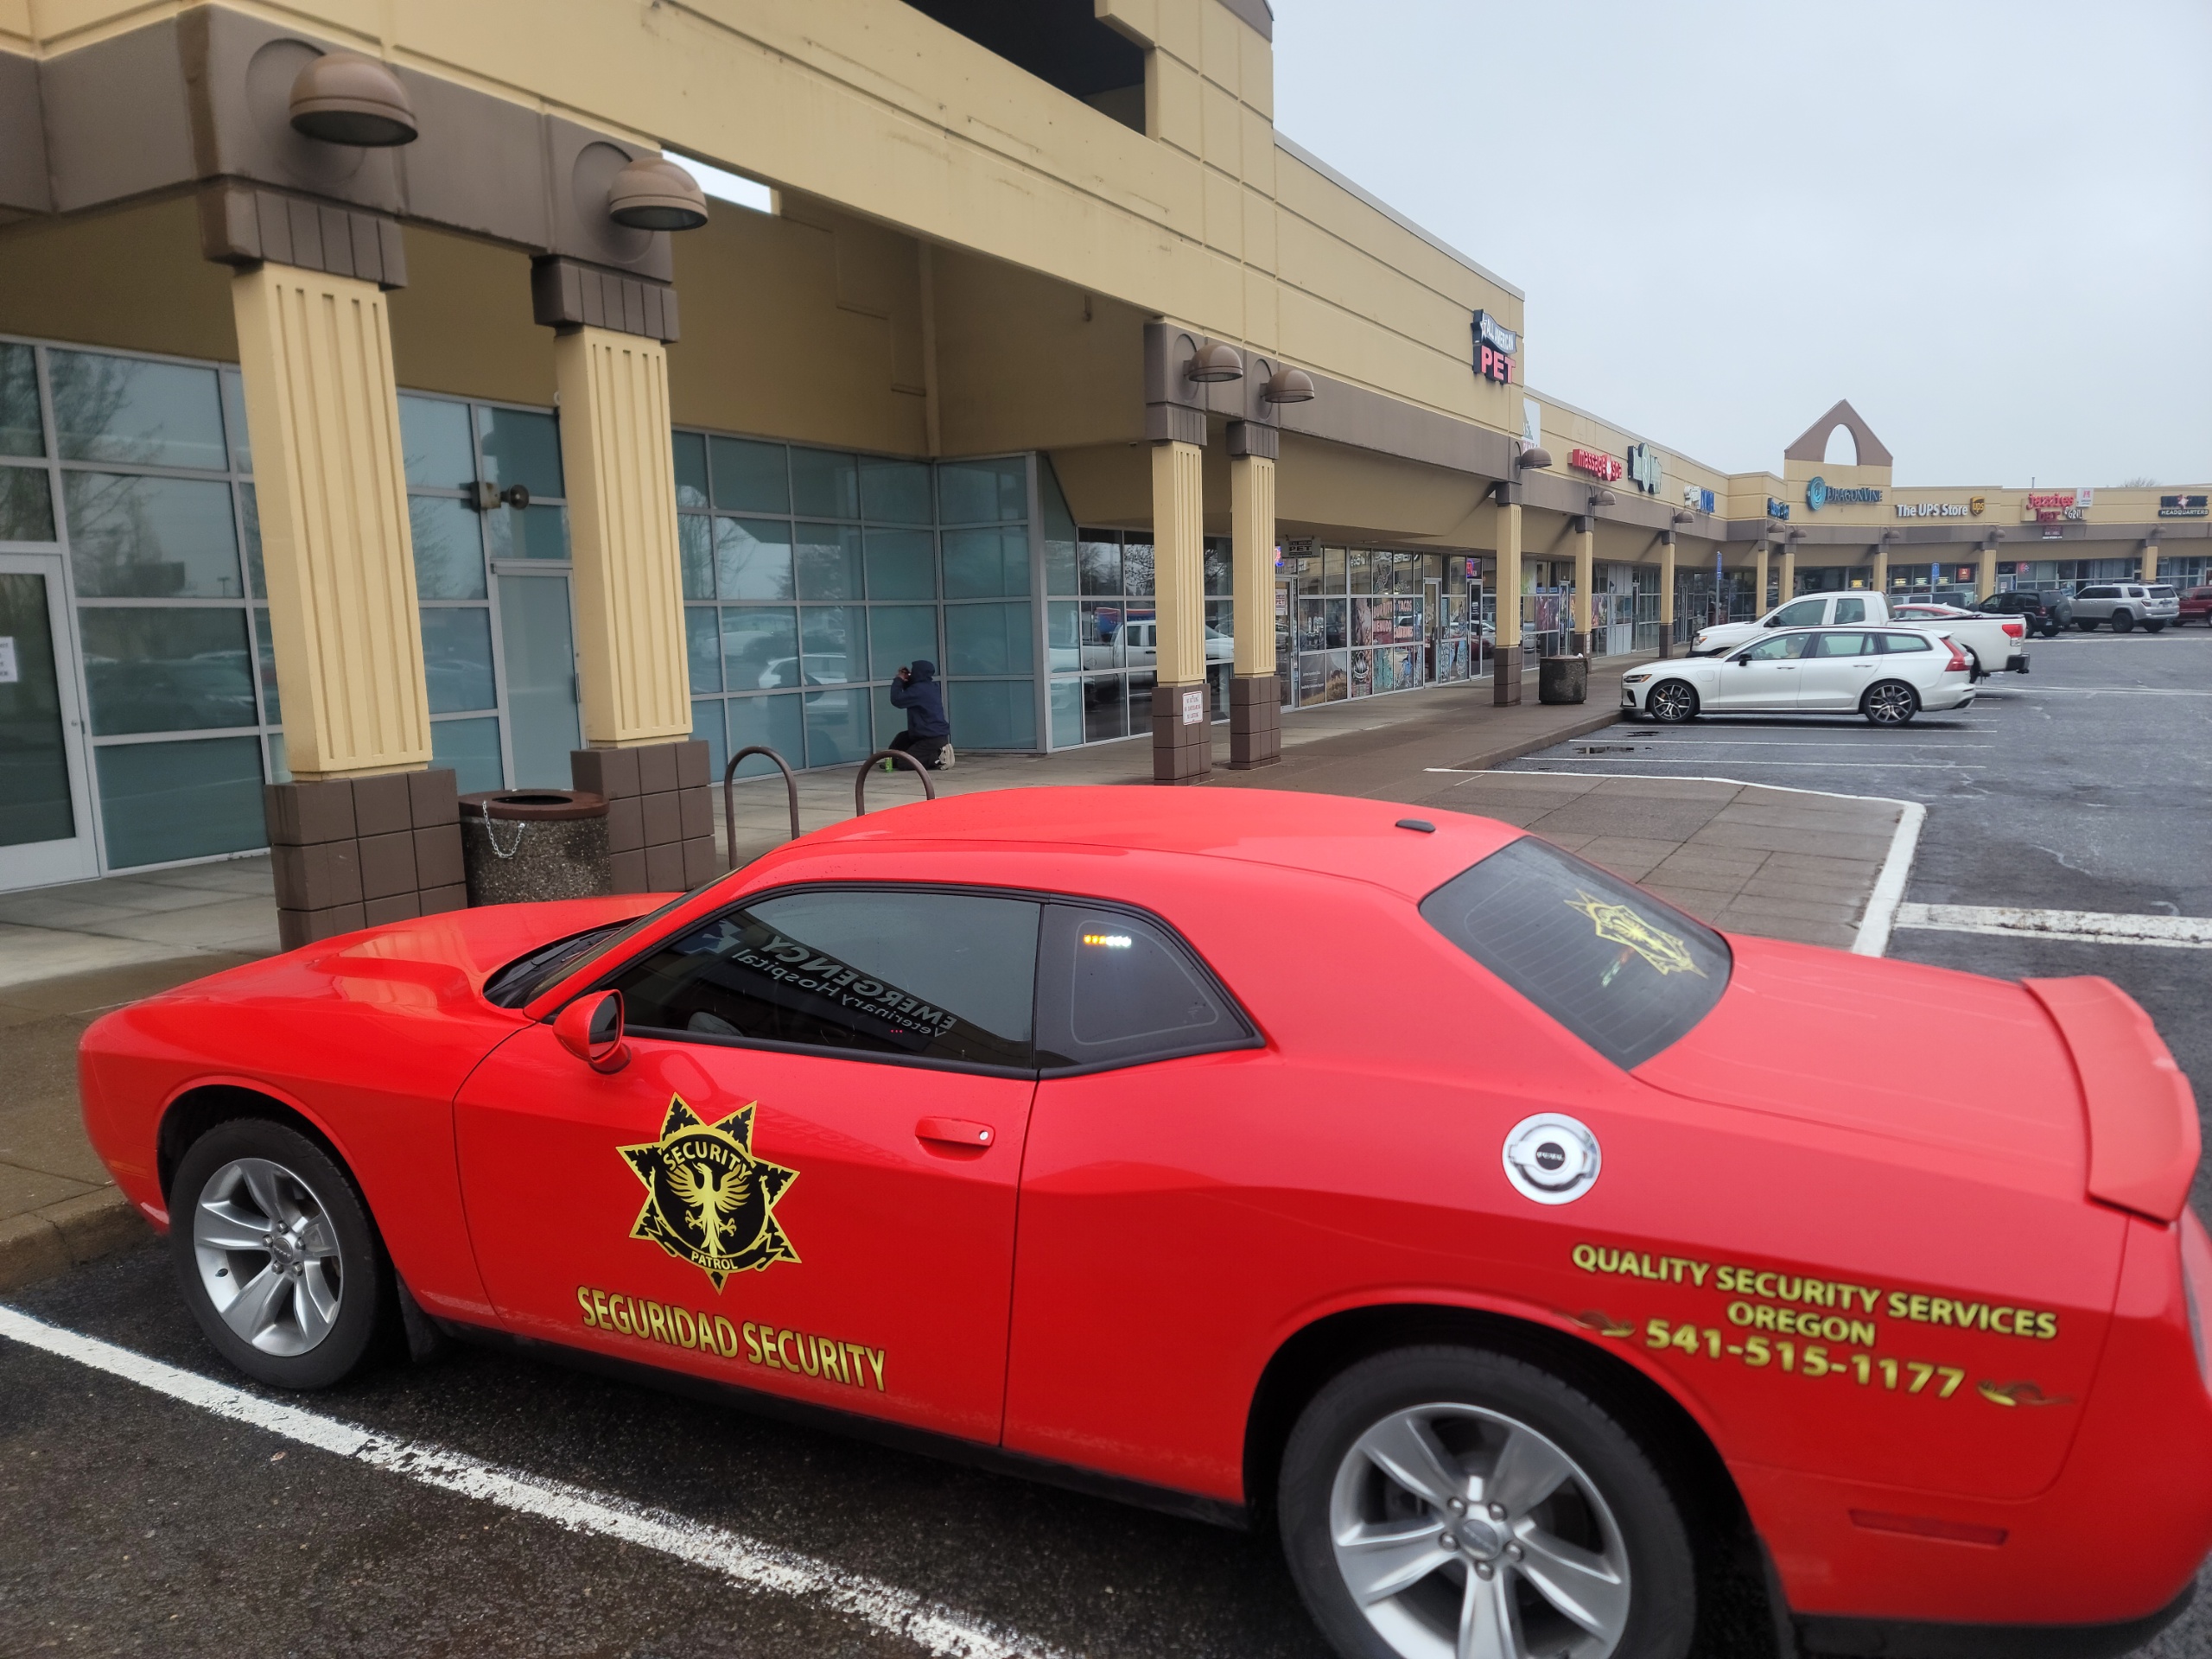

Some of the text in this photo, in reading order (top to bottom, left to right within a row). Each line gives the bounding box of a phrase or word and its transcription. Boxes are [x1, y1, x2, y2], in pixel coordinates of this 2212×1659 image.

[1495, 327, 1514, 351] AMERICAN
[1481, 345, 1516, 384] PET
[1579, 448, 1606, 475] massage
[1611, 461, 1623, 480] spa
[1897, 503, 1968, 517] The UPS Store
[1973, 502, 1985, 513] ups
[2026, 492, 2075, 510] jazzies
[2036, 508, 2061, 523] bar
[663, 1141, 753, 1180] SECURITY
[691, 1251, 739, 1270] PATROL
[1572, 1243, 2058, 1340] QUALITY SECURITY SERVICES
[577, 1286, 886, 1392] SEGURIDAD SECURITY
[1727, 1300, 1877, 1346] OREGON
[1646, 1319, 1966, 1398] 541-515-1177
